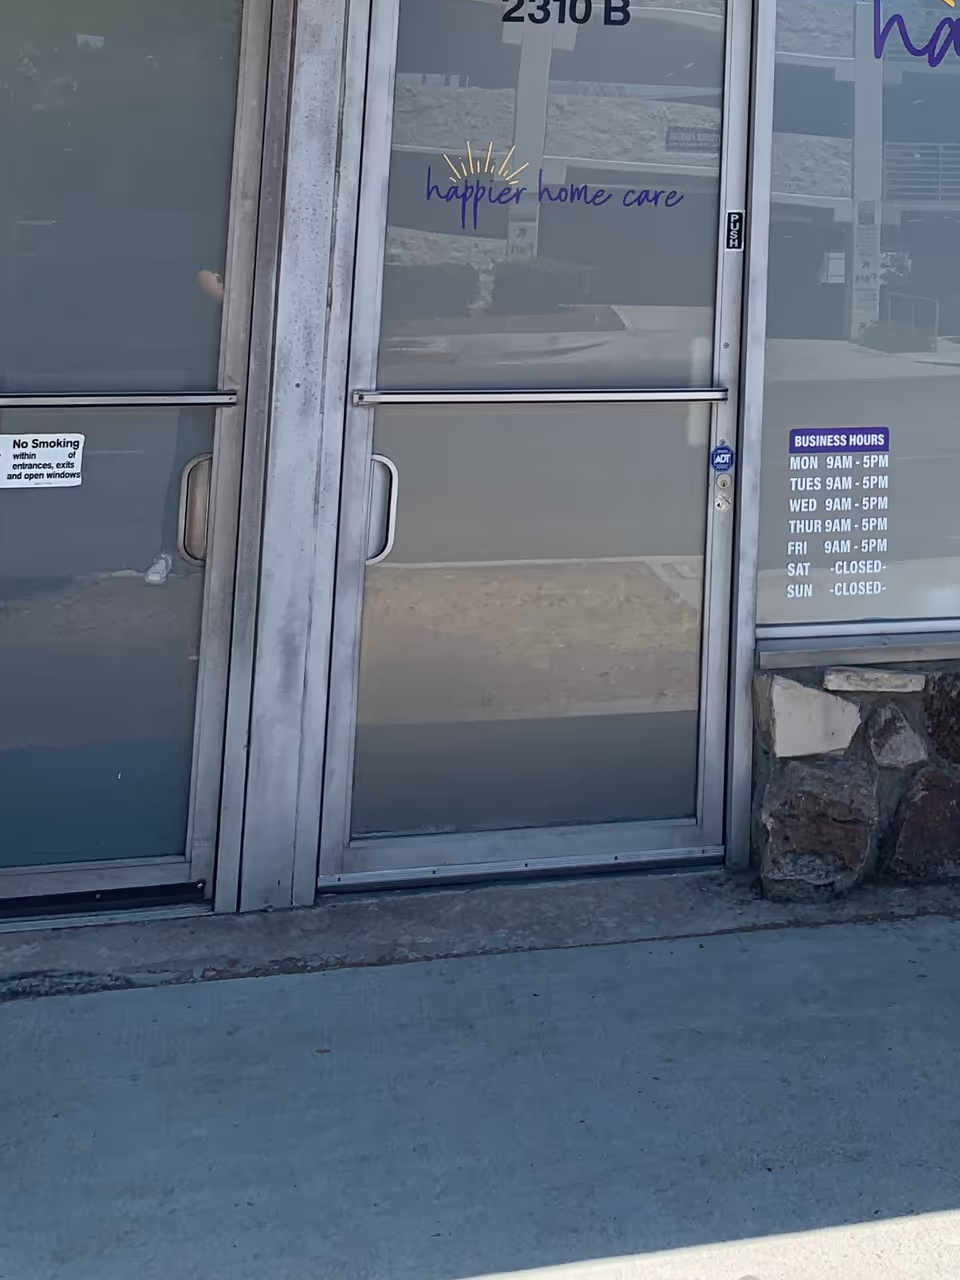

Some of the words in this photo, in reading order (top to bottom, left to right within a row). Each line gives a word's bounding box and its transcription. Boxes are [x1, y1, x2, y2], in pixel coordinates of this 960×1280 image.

[426, 166, 528, 229] happier
[538, 169, 612, 207] home
[622, 184, 684, 208] care
[729, 214, 740, 248] PUSH
[13, 439, 28, 449] No
[31, 438, 80, 450] Smoking
[794, 435, 847, 447] BUSINESS
[849, 434, 885, 446] HOURS
[13, 452, 36, 460] within
[68, 451, 76, 459] of
[714, 454, 731, 464] ADT
[790, 456, 818, 470] MON
[826, 456, 852, 469] 9AM
[863, 455, 889, 468] 5PM
[12, 462, 54, 470] entrances,
[56, 461, 75, 469] exits
[7, 472, 22, 480] and
[24, 472, 44, 481] open
[46, 471, 81, 479] windows
[790, 477, 821, 491] TUES
[825, 476, 852, 490] 9AM
[862, 476, 889, 489] 5PM
[789, 499, 817, 512] WED
[825, 498, 851, 511] 9AM
[862, 497, 888, 510] 5PM
[789, 520, 822, 533] THUR
[824, 519, 851, 532] 9AM
[861, 518, 888, 531] 5PM
[787, 542, 807, 555] FRI
[824, 540, 850, 553] 9AM
[861, 539, 887, 552] 5PM
[787, 563, 811, 577] SAT
[787, 584, 812, 598] SUN
